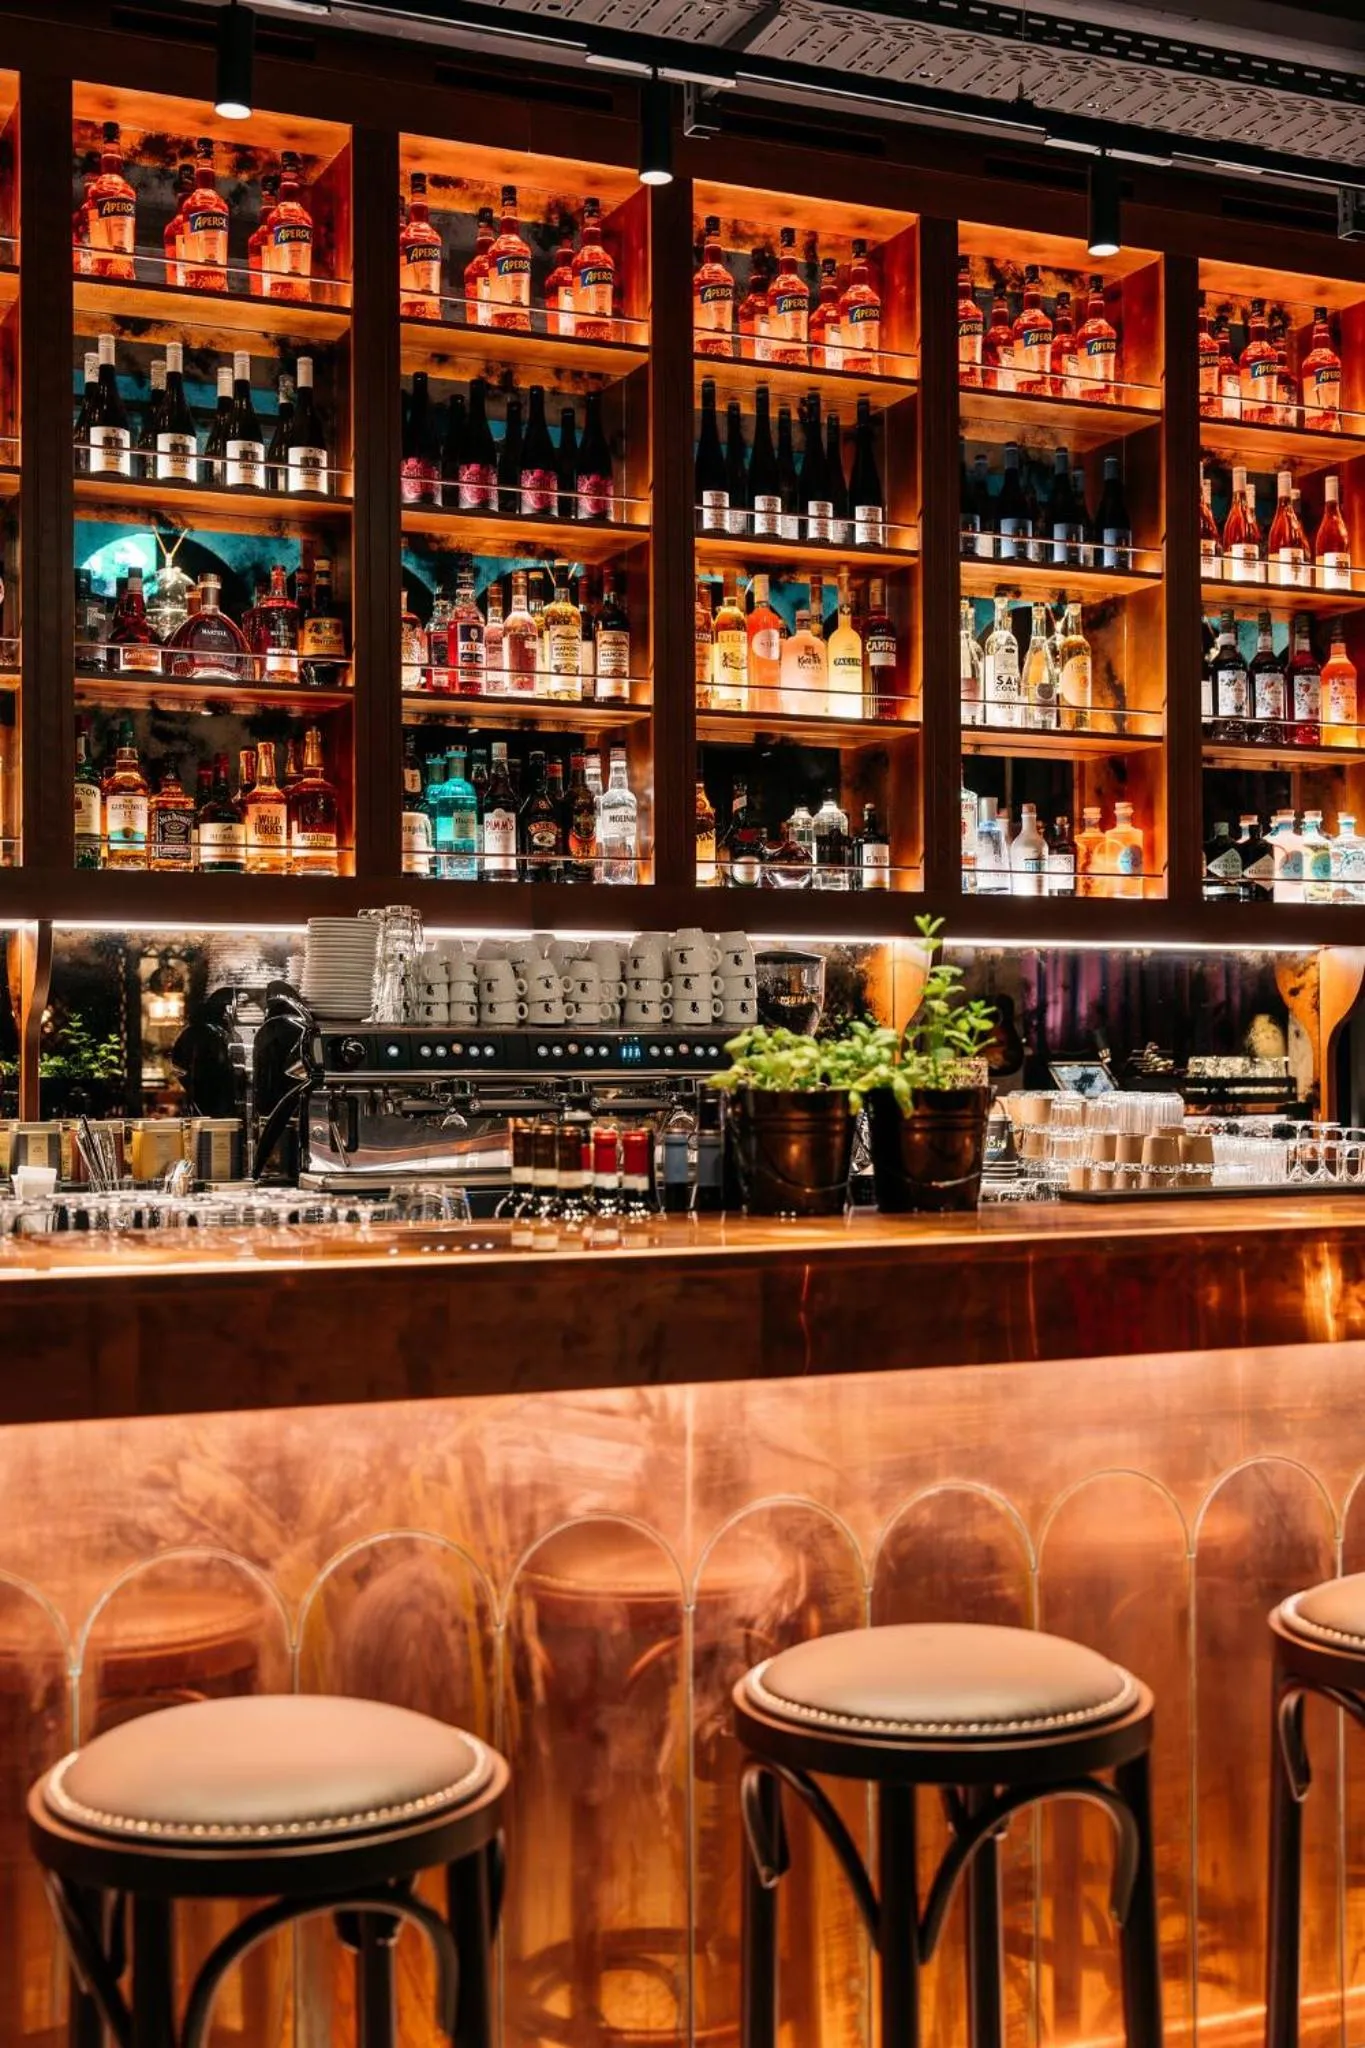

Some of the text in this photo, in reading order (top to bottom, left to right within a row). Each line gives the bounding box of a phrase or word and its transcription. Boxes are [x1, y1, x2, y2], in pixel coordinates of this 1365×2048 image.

[258, 815, 281, 825] WILD
[485, 818, 514, 831] PIMM'S
[254, 823, 283, 834] TURKEY
